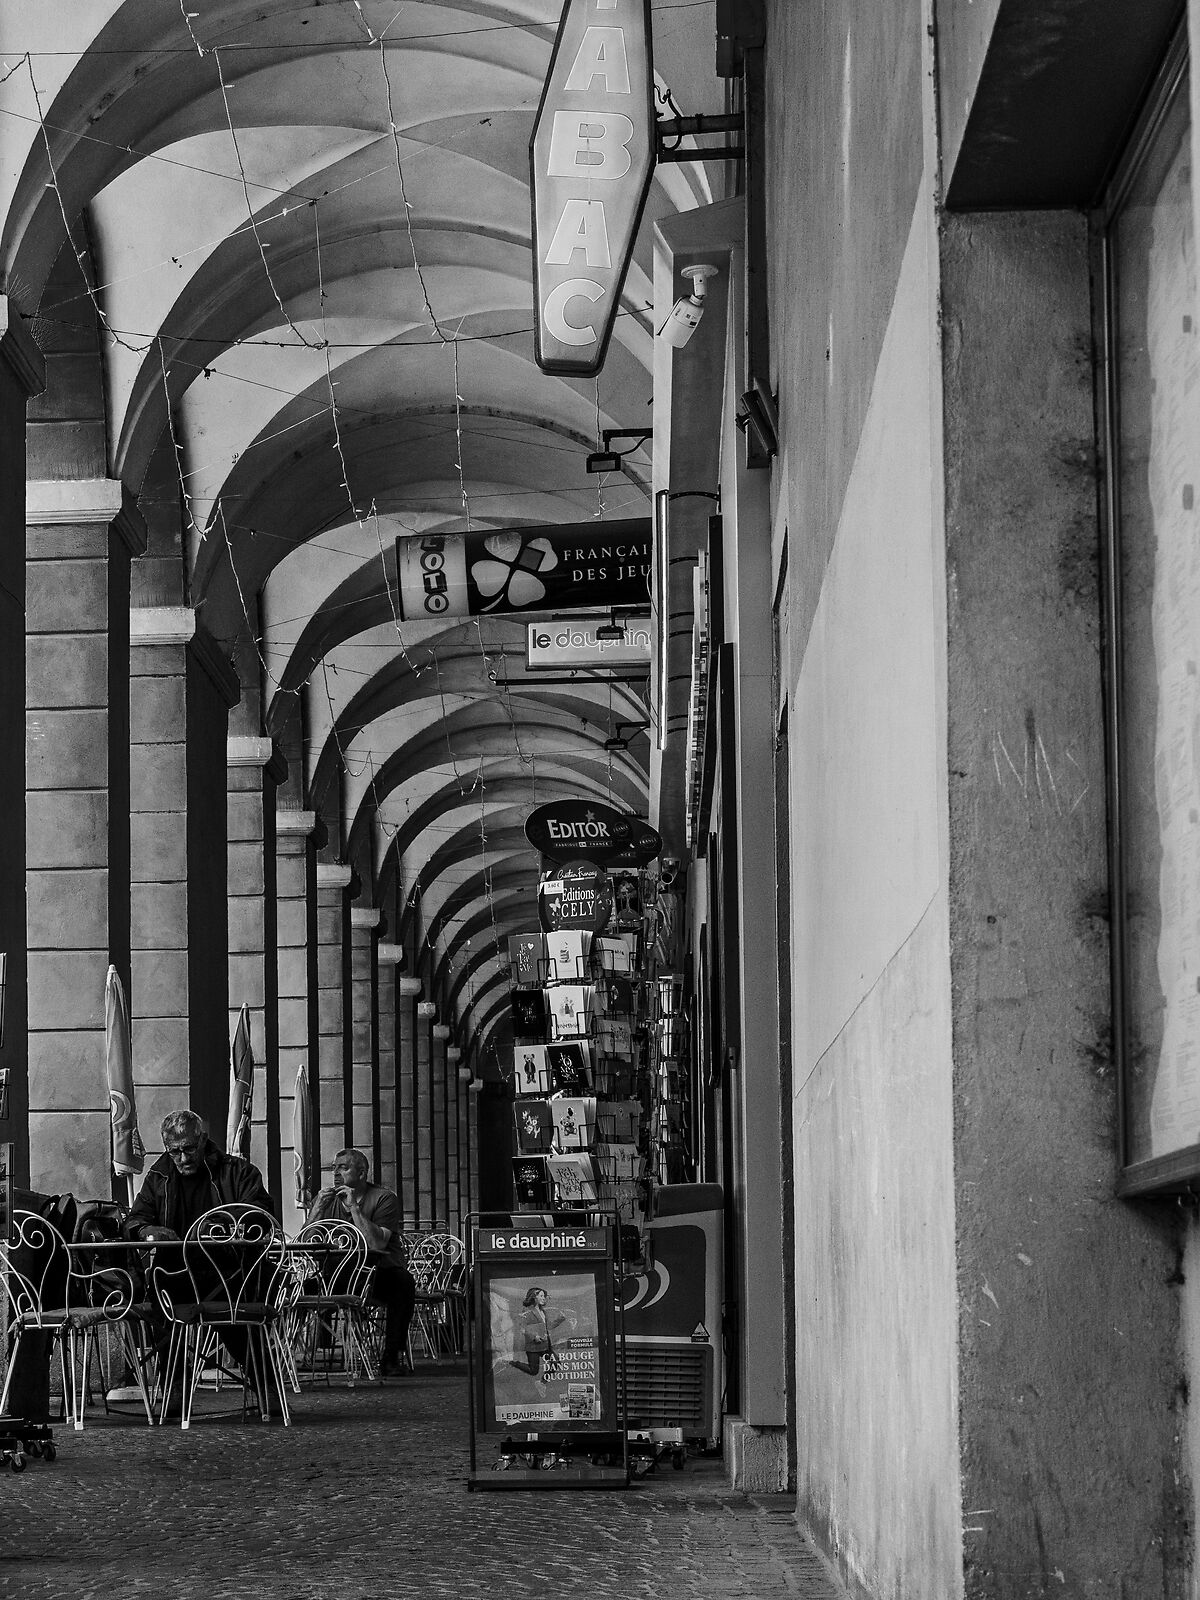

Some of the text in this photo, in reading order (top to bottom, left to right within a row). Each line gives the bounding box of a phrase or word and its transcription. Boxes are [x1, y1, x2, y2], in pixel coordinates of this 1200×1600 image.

[543, 0, 634, 347] ABAC
[420, 535, 450, 614] LOTO
[572, 564, 652, 582] DES JEU
[532, 628, 551, 649] le
[546, 819, 611, 839] EDITOR
[561, 900, 595, 918] CELY
[491, 1231, 587, 1252] le dauphiné
[558, 1350, 595, 1362] BOUGE
[542, 1361, 596, 1372] DANS MON
[543, 1371, 596, 1383] QUOTIDIEN
[501, 1412, 512, 1420] LE
